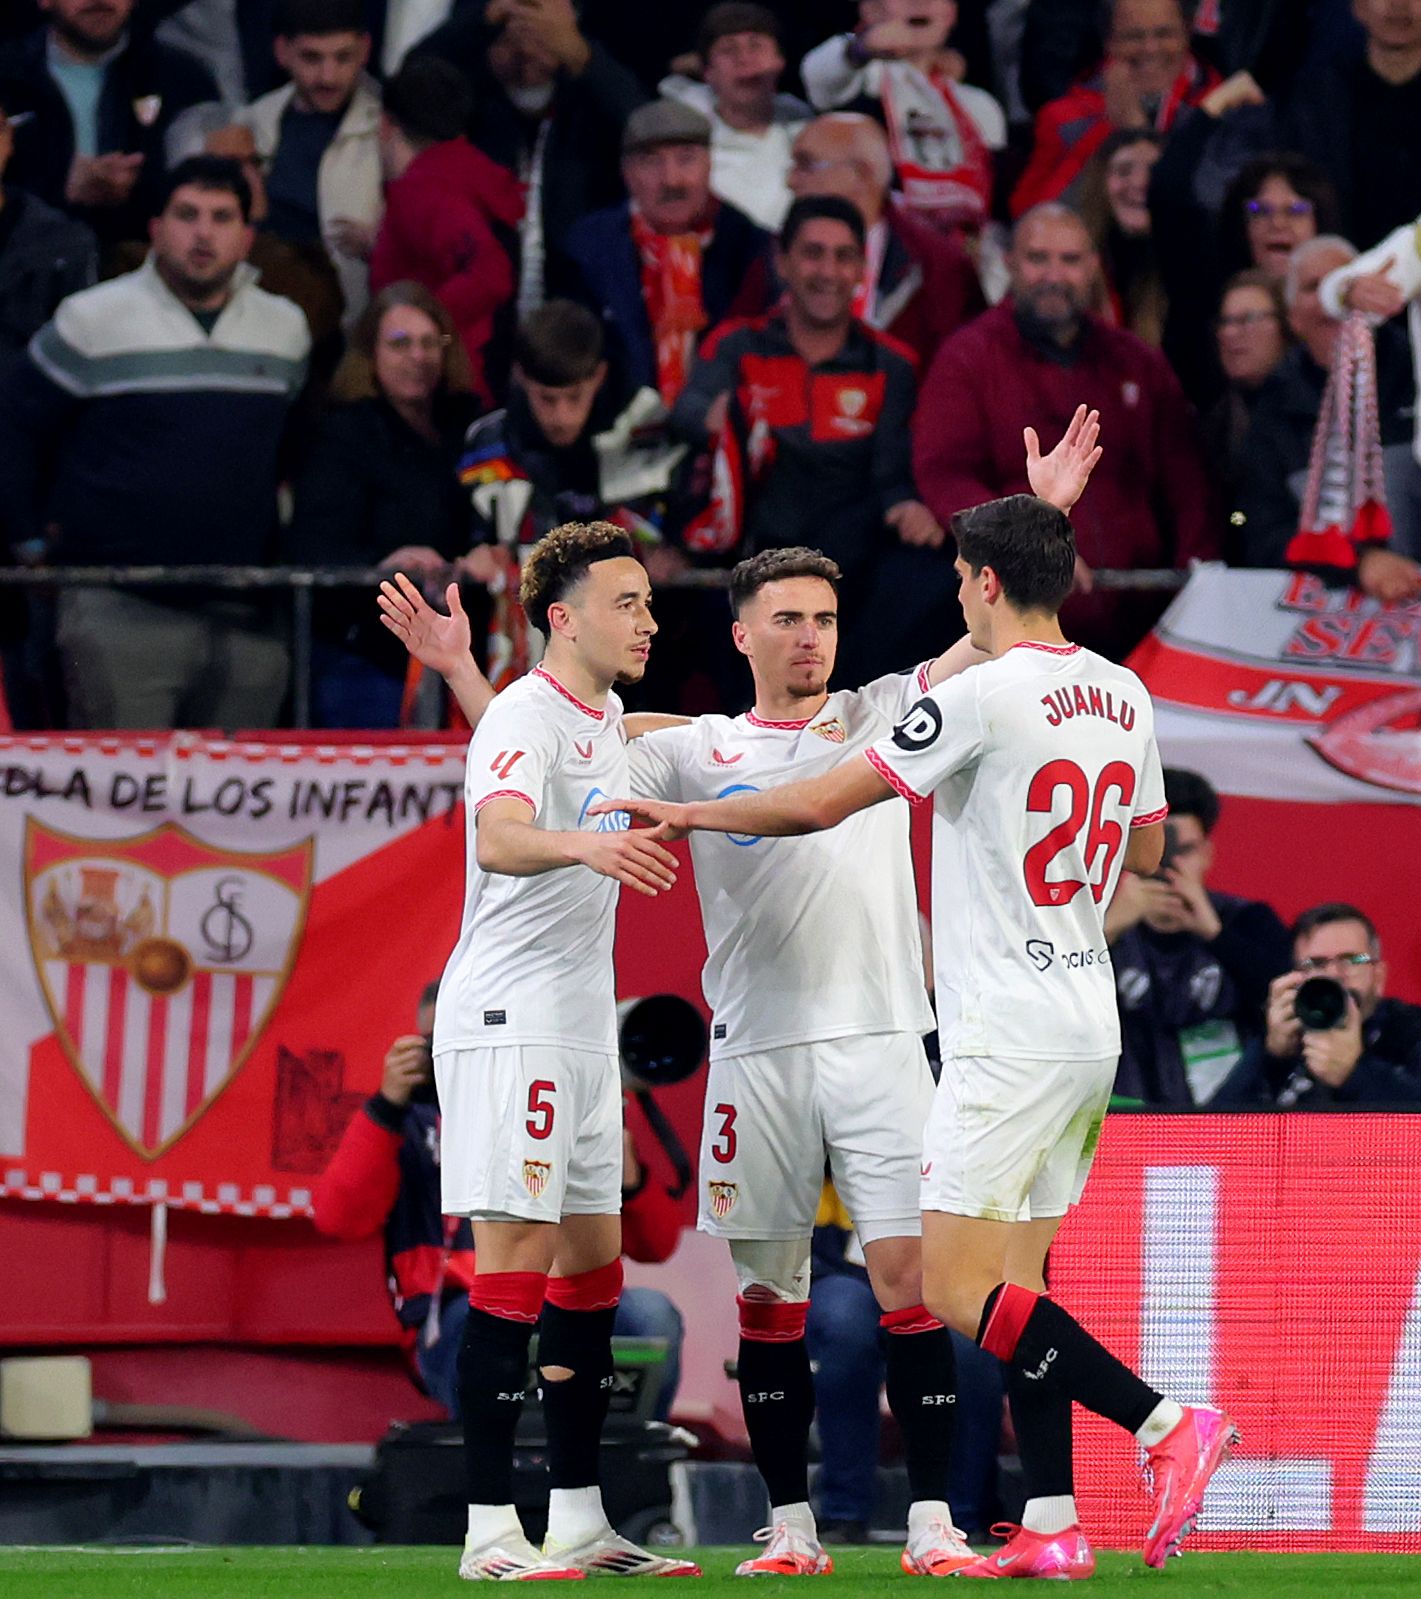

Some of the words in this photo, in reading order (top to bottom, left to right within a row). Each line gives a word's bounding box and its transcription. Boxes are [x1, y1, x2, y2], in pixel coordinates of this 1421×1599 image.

[1040, 684, 1136, 732] JUANLU
[110, 773, 168, 812] DE
[182, 776, 273, 818] LOS
[1023, 758, 1137, 907] 26
[525, 1079, 557, 1140] 5
[711, 1102, 738, 1164] 3
[747, 1391, 785, 1403] SFC
[921, 1394, 957, 1406] SFC
